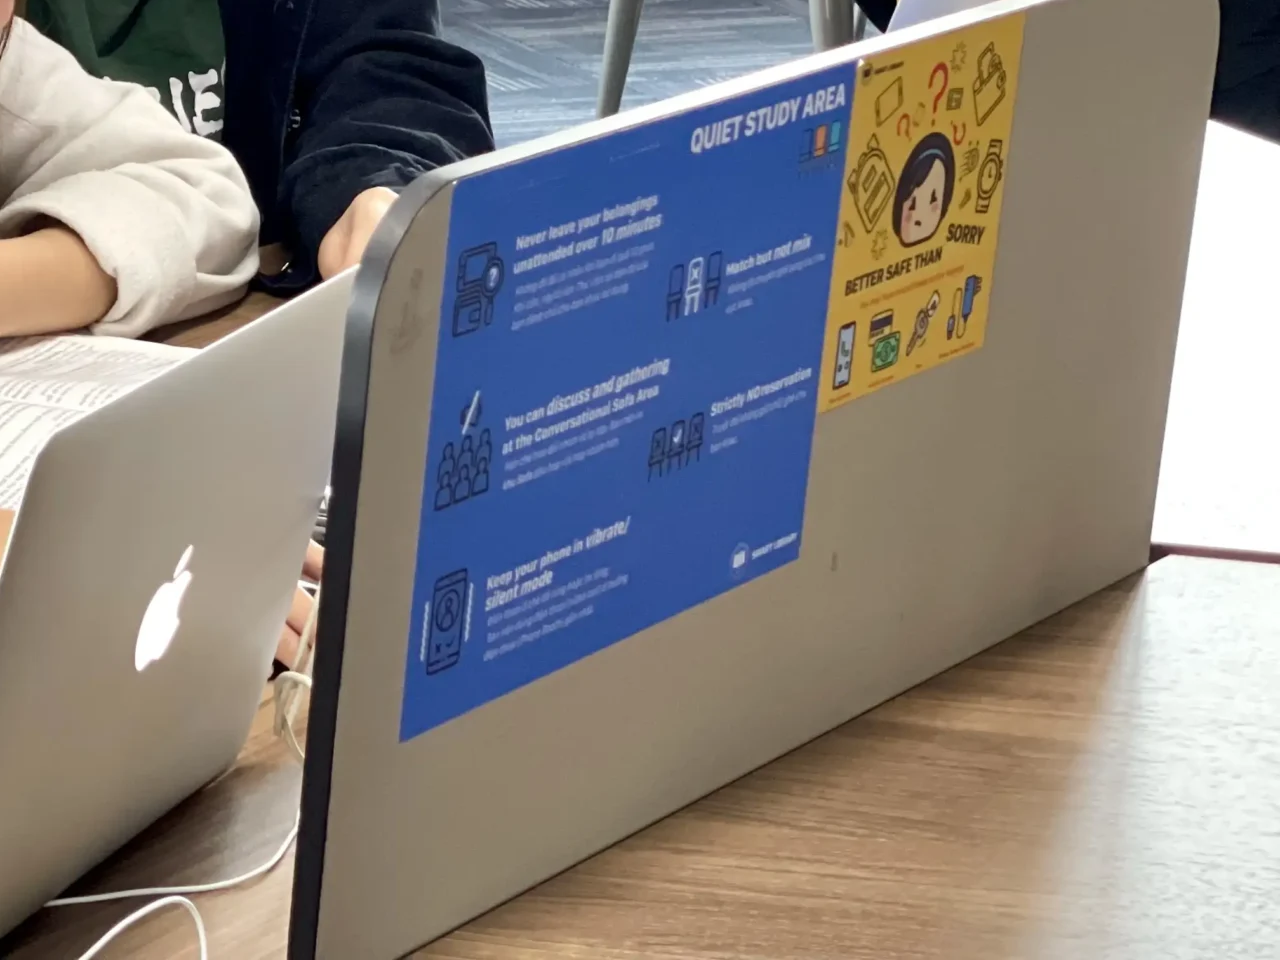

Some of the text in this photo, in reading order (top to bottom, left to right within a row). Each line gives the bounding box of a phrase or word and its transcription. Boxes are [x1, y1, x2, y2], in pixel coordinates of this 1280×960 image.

[691, 83, 845, 154] QUIET STUDY AREA
[513, 214, 662, 274] unattended over 10 minutes
[516, 195, 659, 250] Never leave your belongings
[946, 223, 985, 245] SORRY
[726, 233, 812, 276] Match but not mix
[845, 268, 884, 297] BETTER
[886, 257, 912, 281] SAFE
[915, 246, 943, 270] THAN
[502, 385, 659, 455] at the Conversational Sofa Area
[505, 358, 670, 431] You can discuss and gathering
[487, 515, 631, 590] Keep your phone in vibrate/
[485, 570, 553, 612] silent mode
